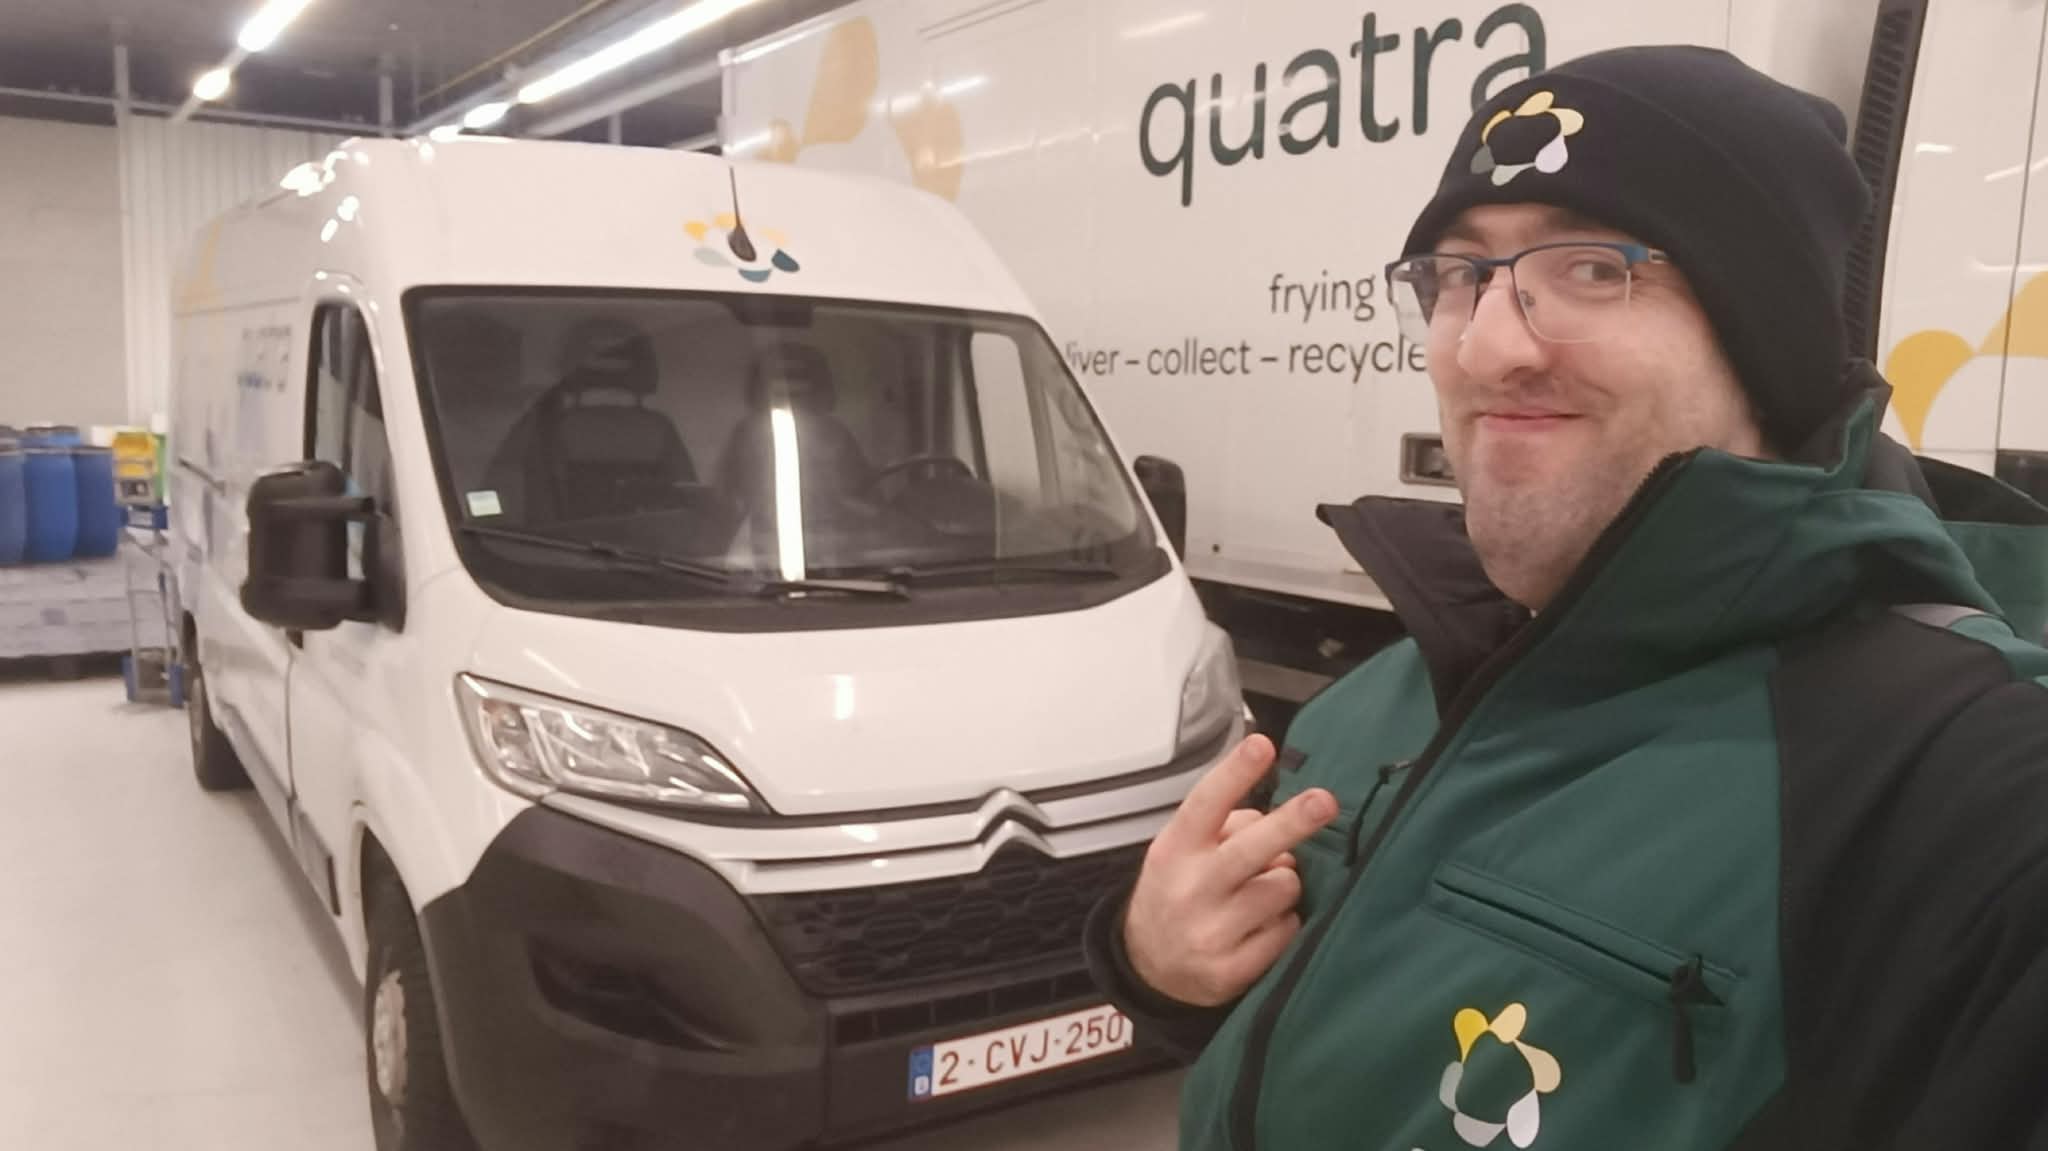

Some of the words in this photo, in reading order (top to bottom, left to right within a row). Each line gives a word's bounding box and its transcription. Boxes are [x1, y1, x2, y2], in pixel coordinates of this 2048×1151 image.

[1139, 3, 1547, 207] quatra
[1269, 269, 1376, 323] frying
[1146, 338, 1250, 376] collect
[1288, 333, 1427, 384] recycle
